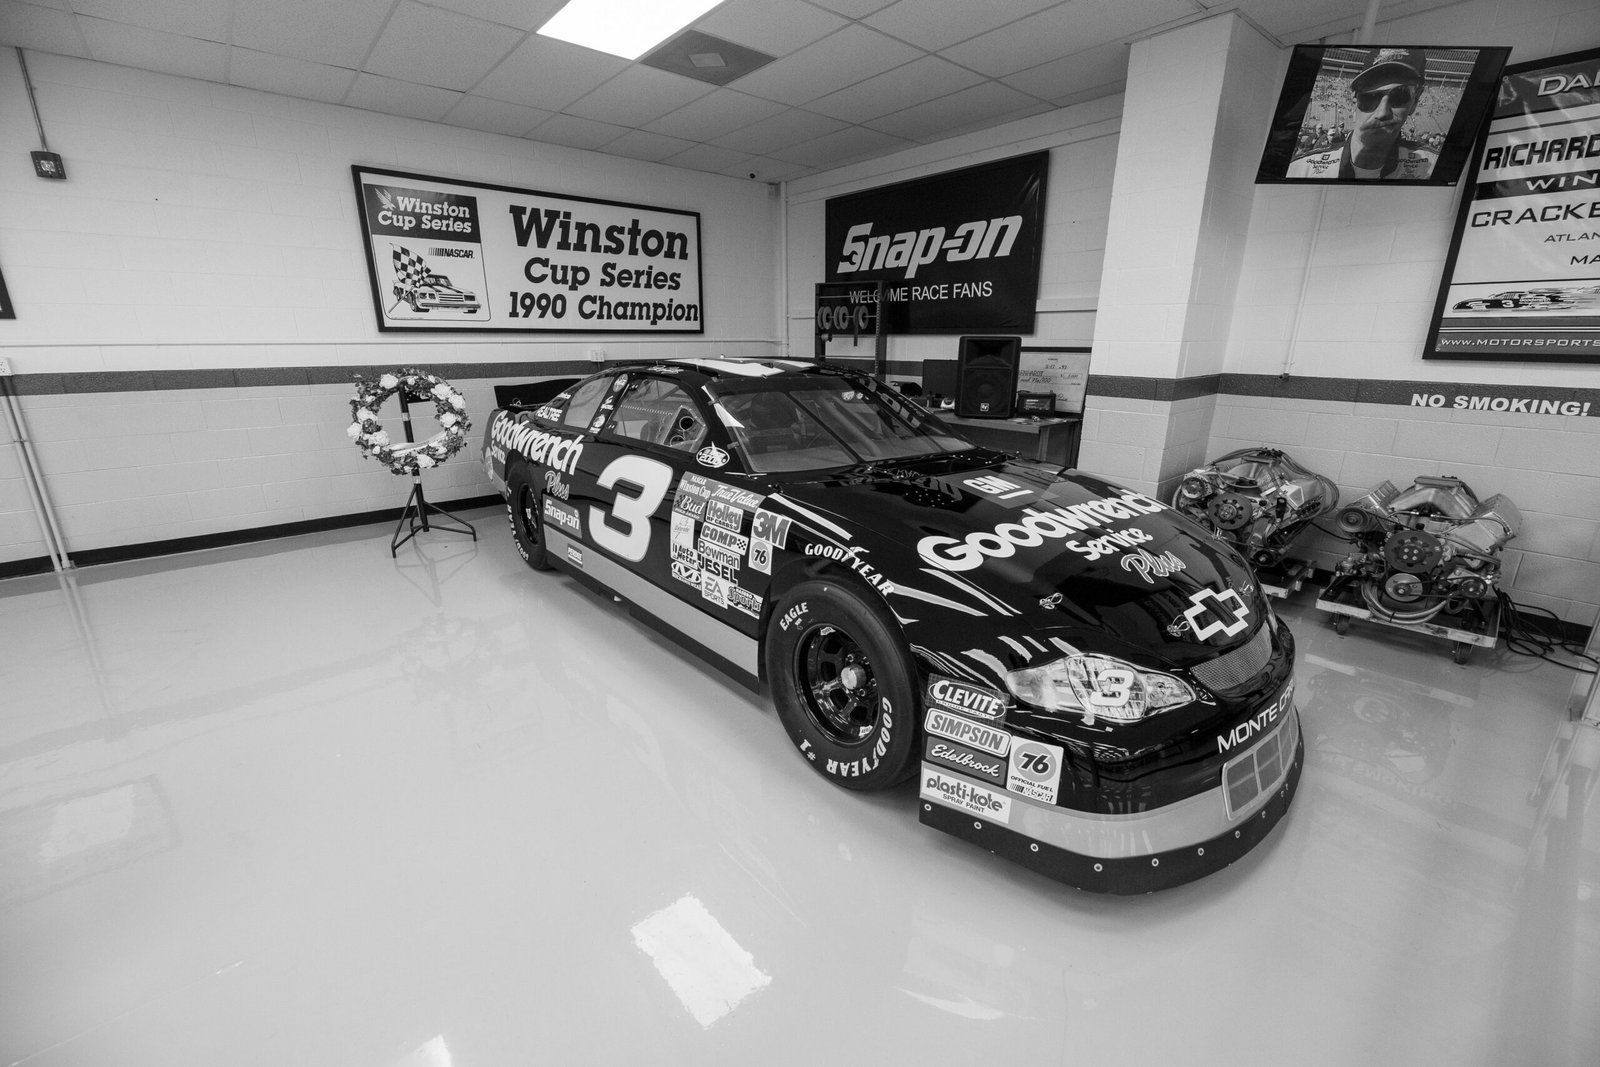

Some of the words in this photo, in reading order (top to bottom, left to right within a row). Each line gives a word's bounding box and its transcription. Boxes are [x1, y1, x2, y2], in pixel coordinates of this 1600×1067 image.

[378, 211, 416, 231] Cup
[421, 215, 472, 233] Series
[397, 196, 470, 218] Winston
[509, 204, 688, 260] Winston
[837, 215, 1023, 279] Snap-on
[444, 247, 474, 259] NASCAR
[524, 257, 590, 291] Cup
[600, 262, 681, 291] Series
[912, 284, 949, 301] RACE
[953, 281, 993, 298] FANS
[1501, 299, 1514, 309] 3
[509, 291, 566, 319] 1990
[578, 295, 699, 325] Champion
[1411, 393, 1446, 408] NO
[1453, 395, 1591, 417] SMOKING!
[491, 409, 585, 476] Goodwrench
[545, 470, 570, 500] Plus
[963, 475, 1021, 496] GM
[544, 499, 580, 530] Snap-on
[589, 454, 674, 563] 3
[680, 495, 706, 515] Bud
[707, 501, 742, 531] Holley
[702, 525, 738, 548] COMP
[753, 511, 791, 548] 3M
[917, 489, 1170, 572] Goodwrench
[1065, 527, 1154, 561] Service
[697, 554, 738, 584] JESEL
[698, 540, 741, 570] Bowman
[754, 548, 767, 565] 76
[804, 543, 895, 597] GOODYEAR
[1121, 548, 1187, 584] Plus
[704, 576, 723, 598] EA
[704, 590, 724, 605] SPORTS
[780, 602, 809, 631] EAGLE
[932, 680, 1002, 715] CLEVITE
[1090, 669, 1135, 707] 3
[826, 697, 893, 777] GOODYEAR
[931, 714, 1004, 751] SIMPSON
[1217, 702, 1278, 754] MONTE
[931, 743, 1000, 778] Edelbrock
[1019, 752, 1051, 774] 76
[926, 775, 1003, 812] plasti-kote
[1010, 775, 1036, 788] OFFICIAL
[1037, 784, 1053, 793] FUEL
[942, 793, 964, 806] SPRAY
[965, 802, 985, 814] PAINT
